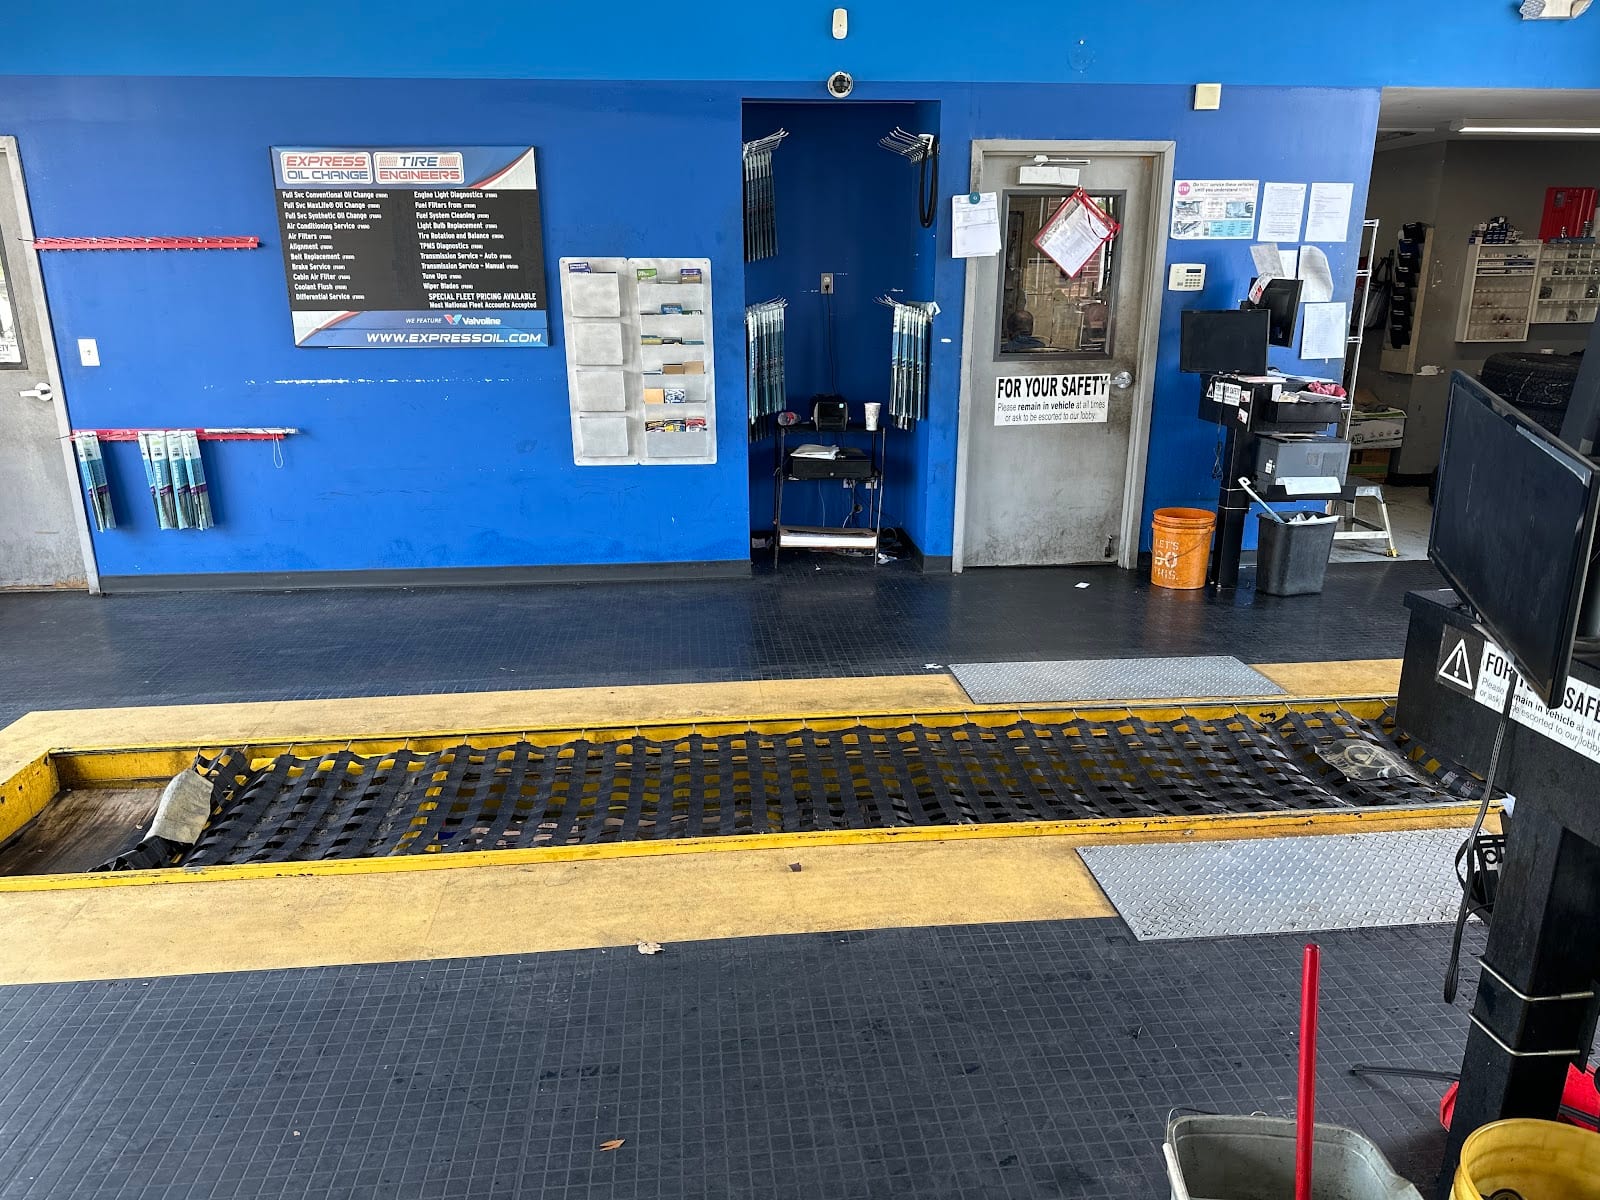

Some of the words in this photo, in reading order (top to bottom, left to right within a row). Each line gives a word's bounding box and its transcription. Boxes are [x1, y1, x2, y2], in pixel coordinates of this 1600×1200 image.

[286, 156, 366, 167] EXPRESS
[400, 156, 438, 167] TIRE
[287, 170, 310, 180] OIL
[312, 170, 368, 180] CHANGE
[379, 170, 460, 180] ENGINEERS
[282, 191, 293, 199] Full
[294, 191, 305, 199] Svc
[305, 191, 343, 199] Conventional
[344, 191, 352, 199] Oil
[353, 191, 374, 200] Change
[414, 191, 434, 200] Engine
[435, 191, 450, 200] Light
[450, 191, 483, 200] Diagnostics
[284, 201, 295, 209] Full
[295, 201, 306, 209] Svc
[335, 201, 343, 209] Oil
[344, 201, 366, 210] Change
[415, 201, 427, 209] Fuel
[428, 201, 447, 209] Filters
[448, 201, 462, 209] from
[308, 212, 336, 220] Synthetic
[346, 212, 367, 220] Change
[429, 212, 450, 220] System
[451, 212, 475, 220] Cleaning
[297, 222, 333, 230] Conditioning
[417, 222, 432, 230] Light
[447, 222, 483, 230] Replacement
[289, 243, 319, 251] Alignment
[436, 242, 469, 250] Diagnostics
[304, 253, 340, 261] Replacement
[420, 252, 456, 260] Transmission
[457, 252, 478, 260] Service
[484, 252, 498, 260] Auto
[421, 262, 458, 270] Transmission
[458, 262, 480, 270] Service
[485, 262, 505, 270] Manual
[436, 272, 448, 280] Ups
[423, 282, 440, 290] Wiper
[428, 292, 455, 300] SPECIAL
[456, 292, 475, 300] FLEET
[476, 292, 502, 300] PRICING
[503, 292, 536, 300] AVAILABLE
[511, 302, 537, 310] Accepted
[462, 316, 501, 325] Valvoline
[366, 333, 542, 343] WWW.EXPRESSOIL.COM
[997, 378, 1021, 398] FOR
[1025, 377, 1058, 398] YOUR
[1061, 376, 1108, 396] SAFETY
[998, 402, 1016, 412] Please
[1018, 402, 1041, 411] remain
[1042, 402, 1049, 410] in
[1050, 401, 1075, 410] vehicle
[1076, 401, 1082, 409] at
[1082, 400, 1090, 409] all
[1090, 400, 1106, 409] times
[1023, 413, 1029, 421] to
[1030, 413, 1037, 421] be
[1038, 412, 1061, 421] escorted
[1063, 412, 1069, 420] to
[1155, 539, 1179, 551] LET'S
[1154, 567, 1178, 580] THIS.
[1482, 677, 1504, 693] Please
[1513, 694, 1533, 708] main
[1535, 704, 1542, 713] in
[1545, 708, 1575, 728] vehicle
[1576, 724, 1584, 733] at
[1585, 728, 1596, 737] all
[1488, 693, 1498, 703] ask
[1521, 709, 1553, 731] escorted
[1555, 725, 1563, 734] to
[1564, 729, 1578, 741] our
